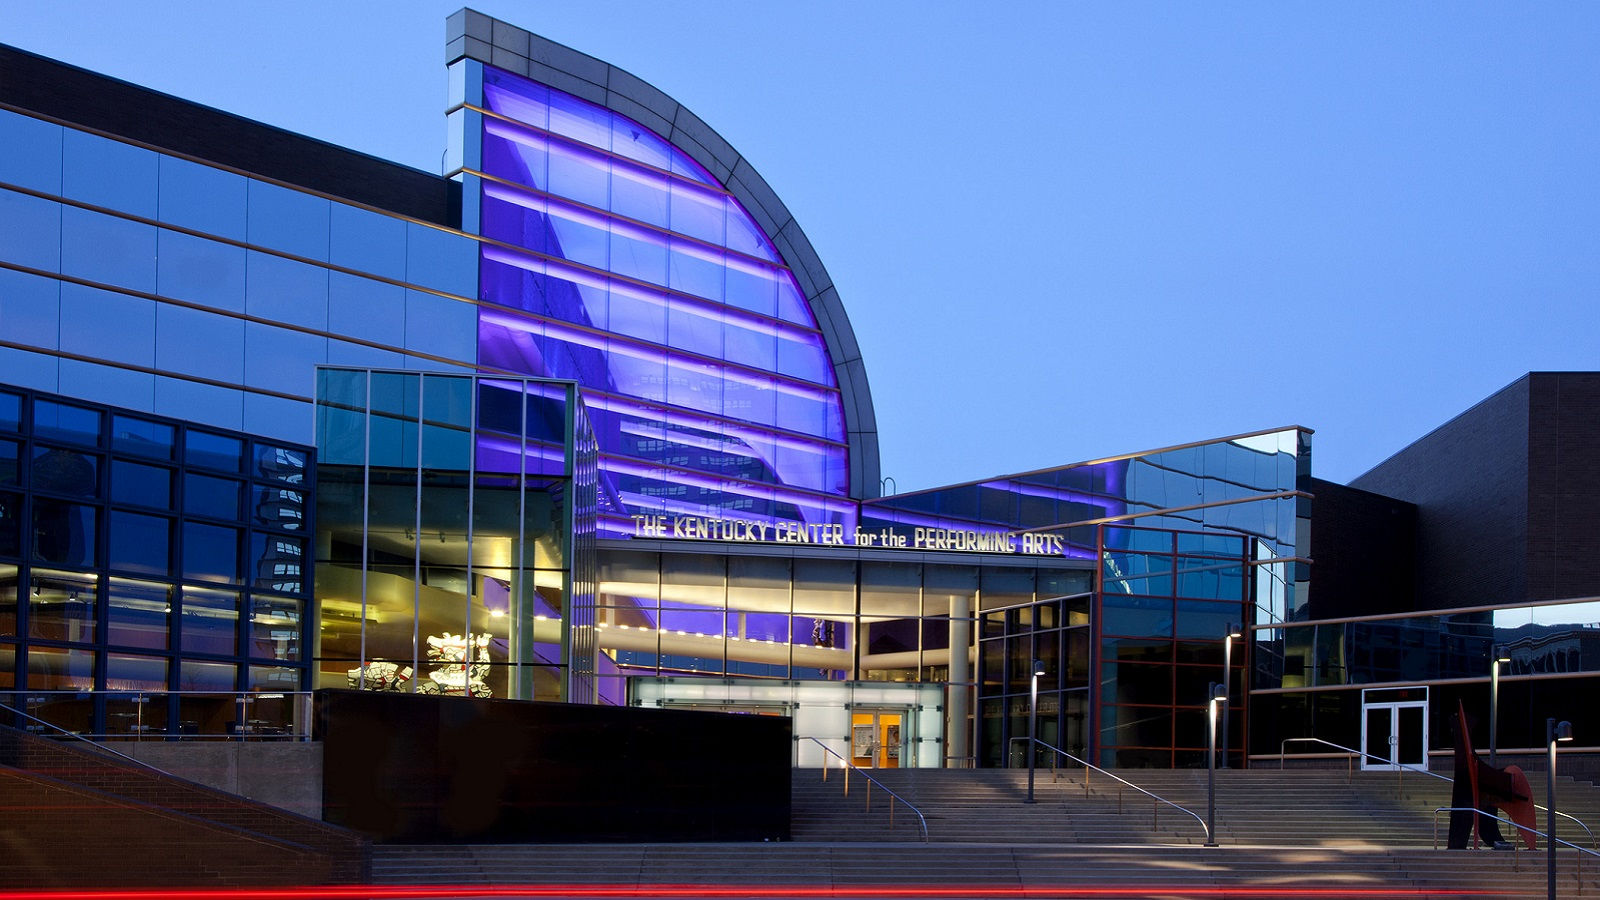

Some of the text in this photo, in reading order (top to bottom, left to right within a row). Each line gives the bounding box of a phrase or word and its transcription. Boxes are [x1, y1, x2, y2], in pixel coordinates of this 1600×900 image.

[631, 514, 1065, 555] THE KENTUCKY CENTER for the PERFORMING ARTS
